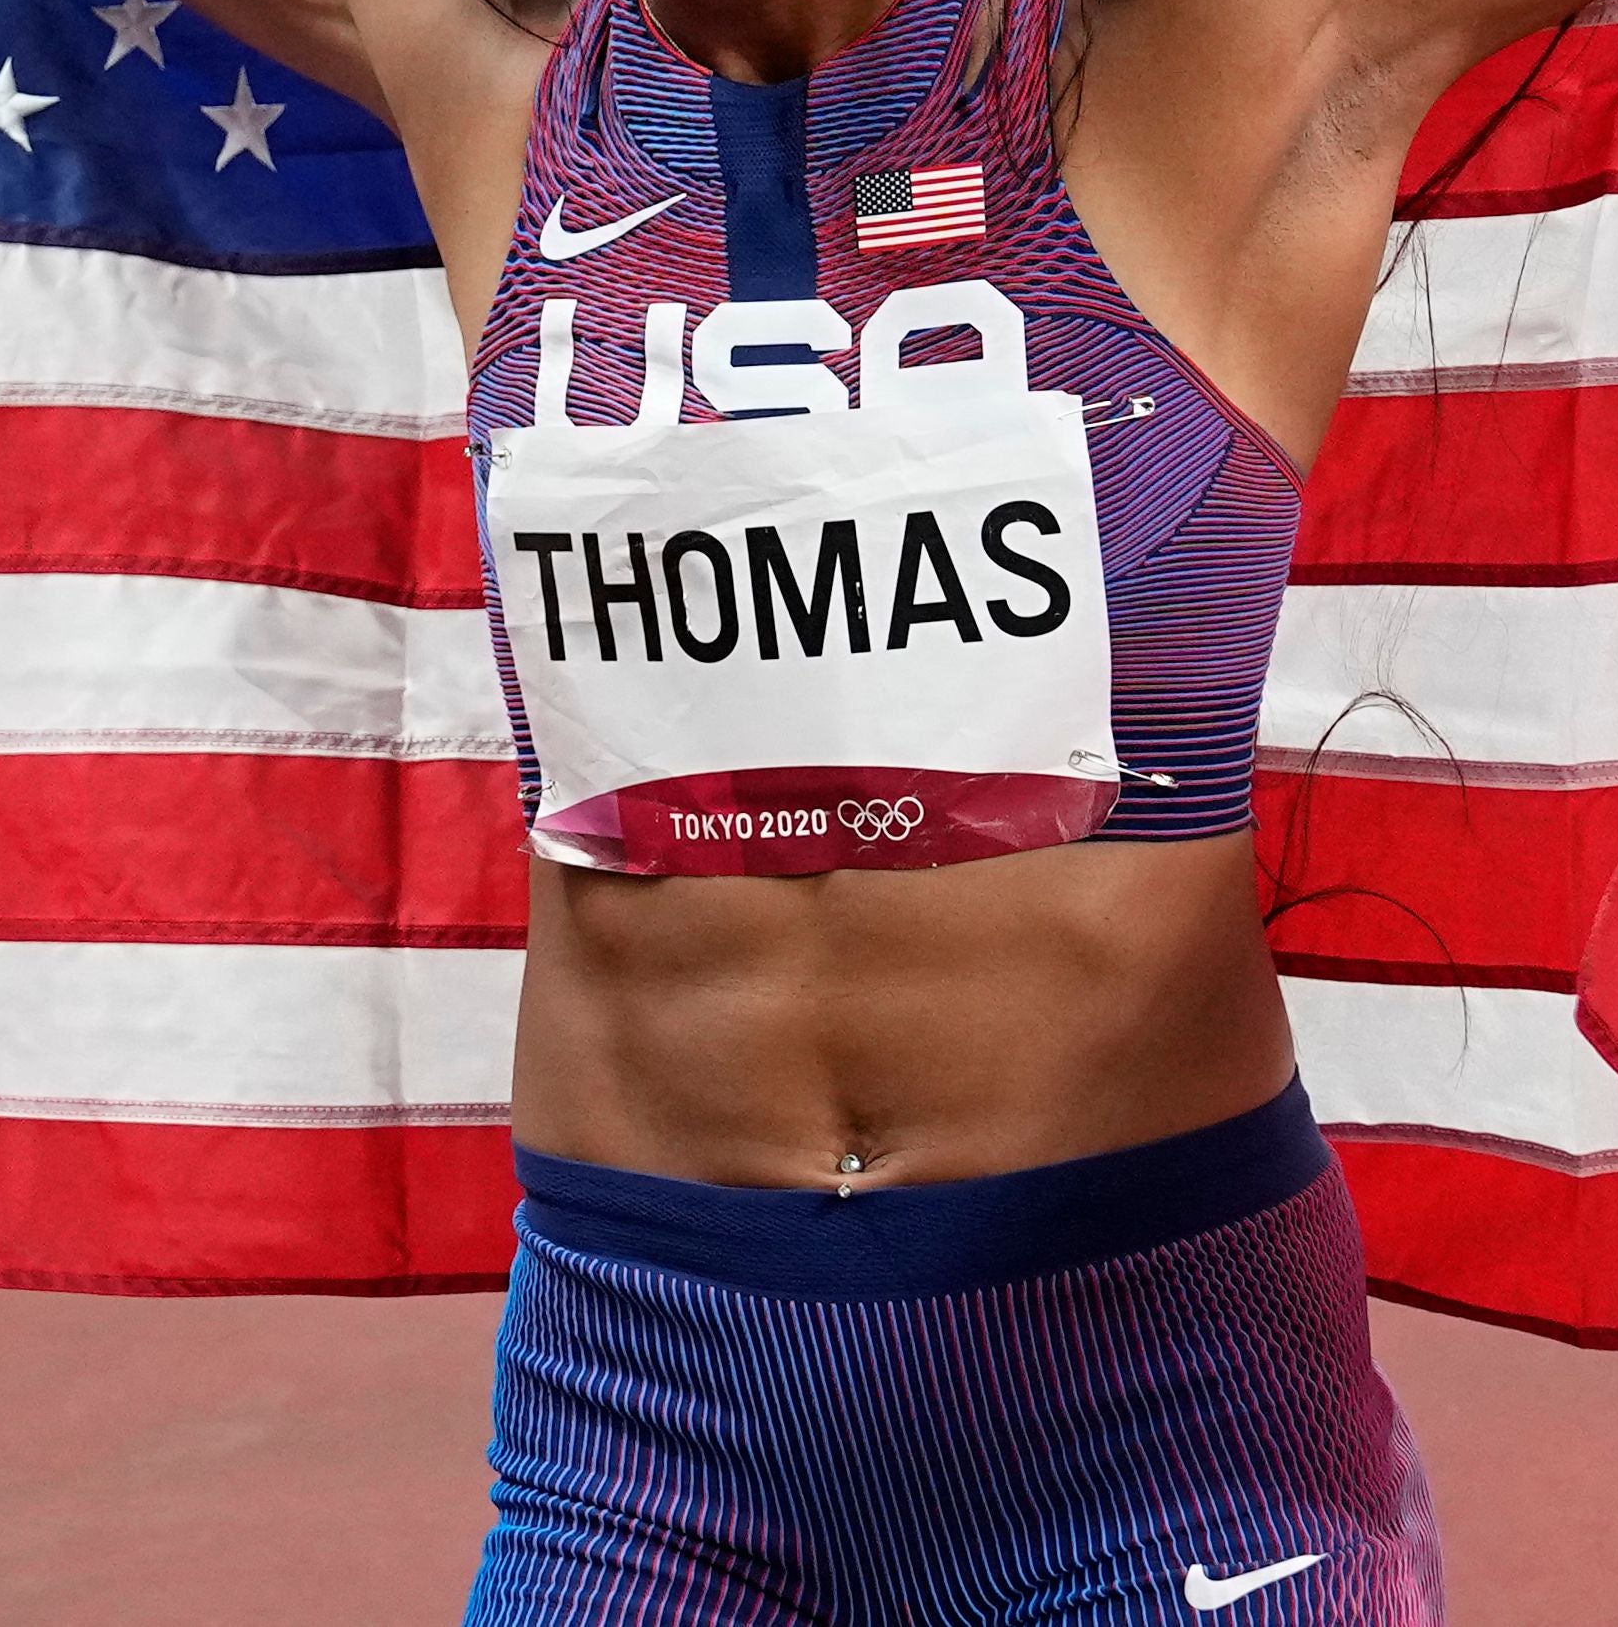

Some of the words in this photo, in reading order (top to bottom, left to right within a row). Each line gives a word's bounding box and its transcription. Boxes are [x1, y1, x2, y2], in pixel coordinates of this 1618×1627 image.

[534, 278, 1030, 427] USA
[514, 500, 1071, 663] THOMAS
[670, 812, 753, 840] TOKYO
[759, 808, 828, 839] 2020
